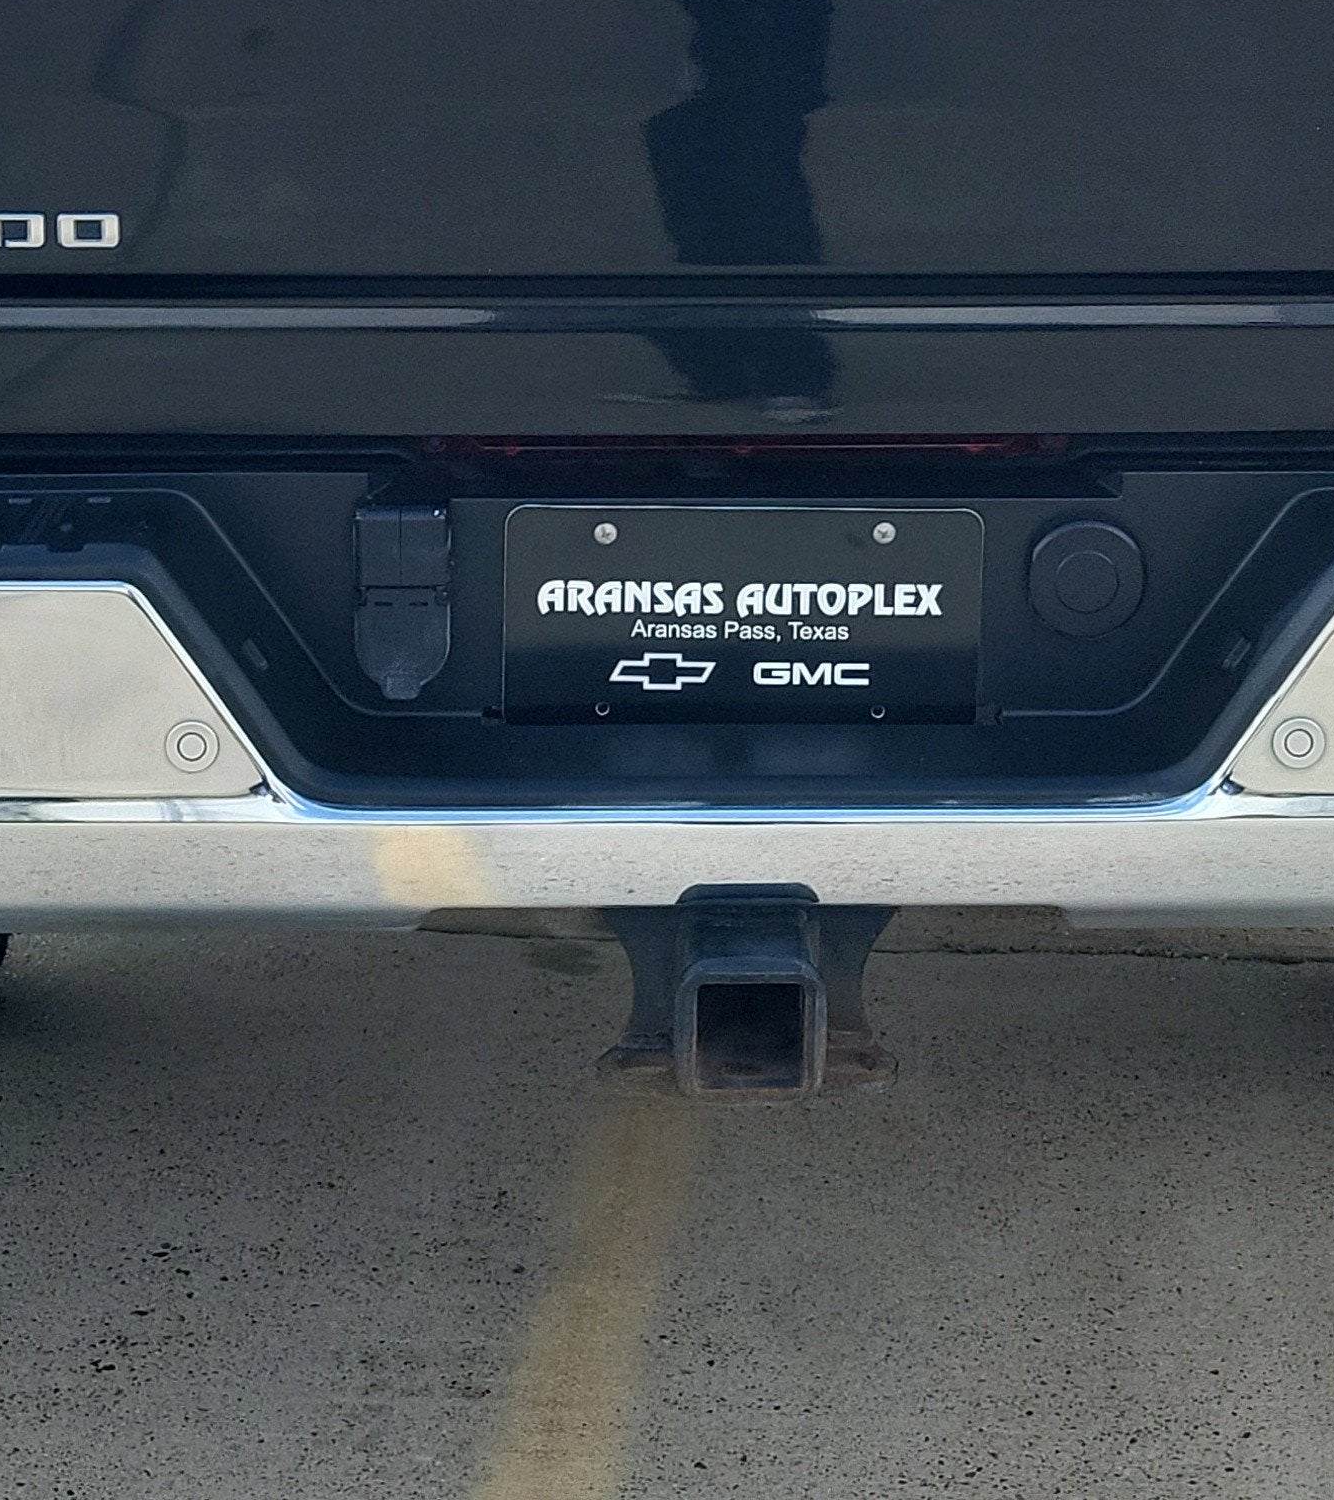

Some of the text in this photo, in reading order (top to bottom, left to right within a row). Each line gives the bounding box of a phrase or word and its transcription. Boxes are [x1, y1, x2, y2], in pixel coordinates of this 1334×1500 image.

[537, 579, 943, 618] ARANSAS AUTOPLEX
[630, 619, 850, 642] Aransas Pass, Texas
[753, 662, 870, 686] GMC
